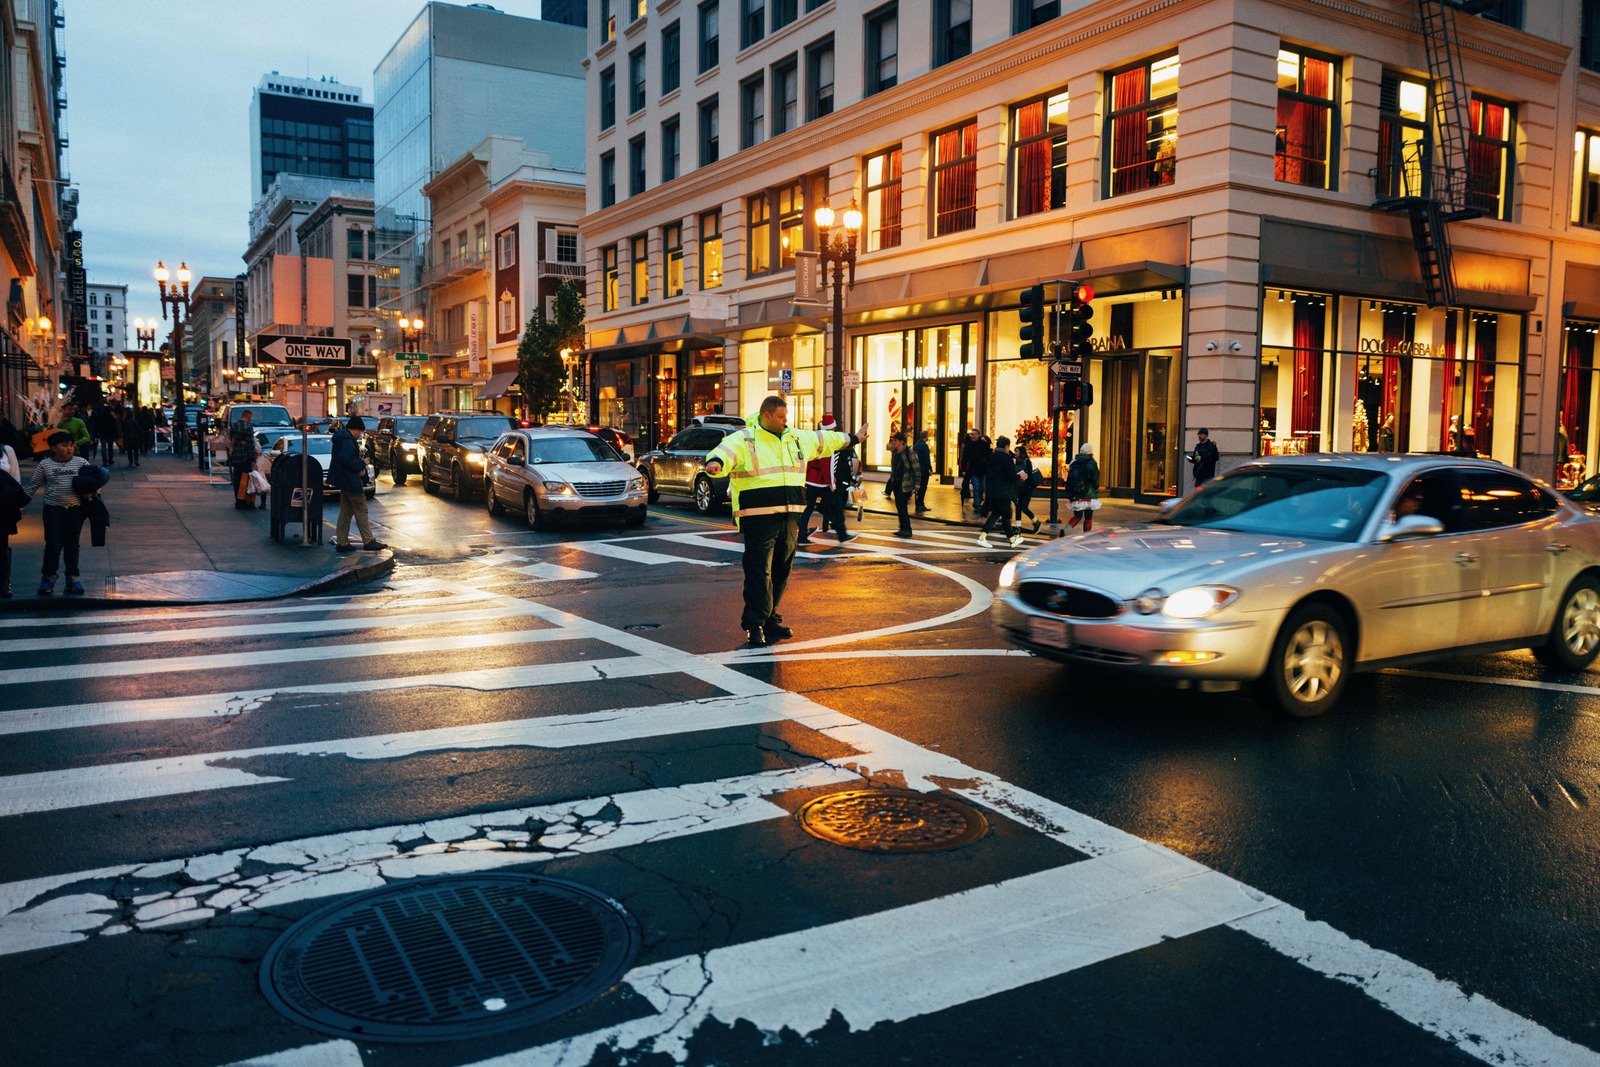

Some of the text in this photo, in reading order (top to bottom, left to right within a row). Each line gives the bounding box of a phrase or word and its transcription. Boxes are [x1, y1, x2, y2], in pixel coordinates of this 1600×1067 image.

[285, 345, 341, 358] ONE WAY
[1361, 338, 1390, 353] DOLCE
[1398, 341, 1446, 358] GABBANA
